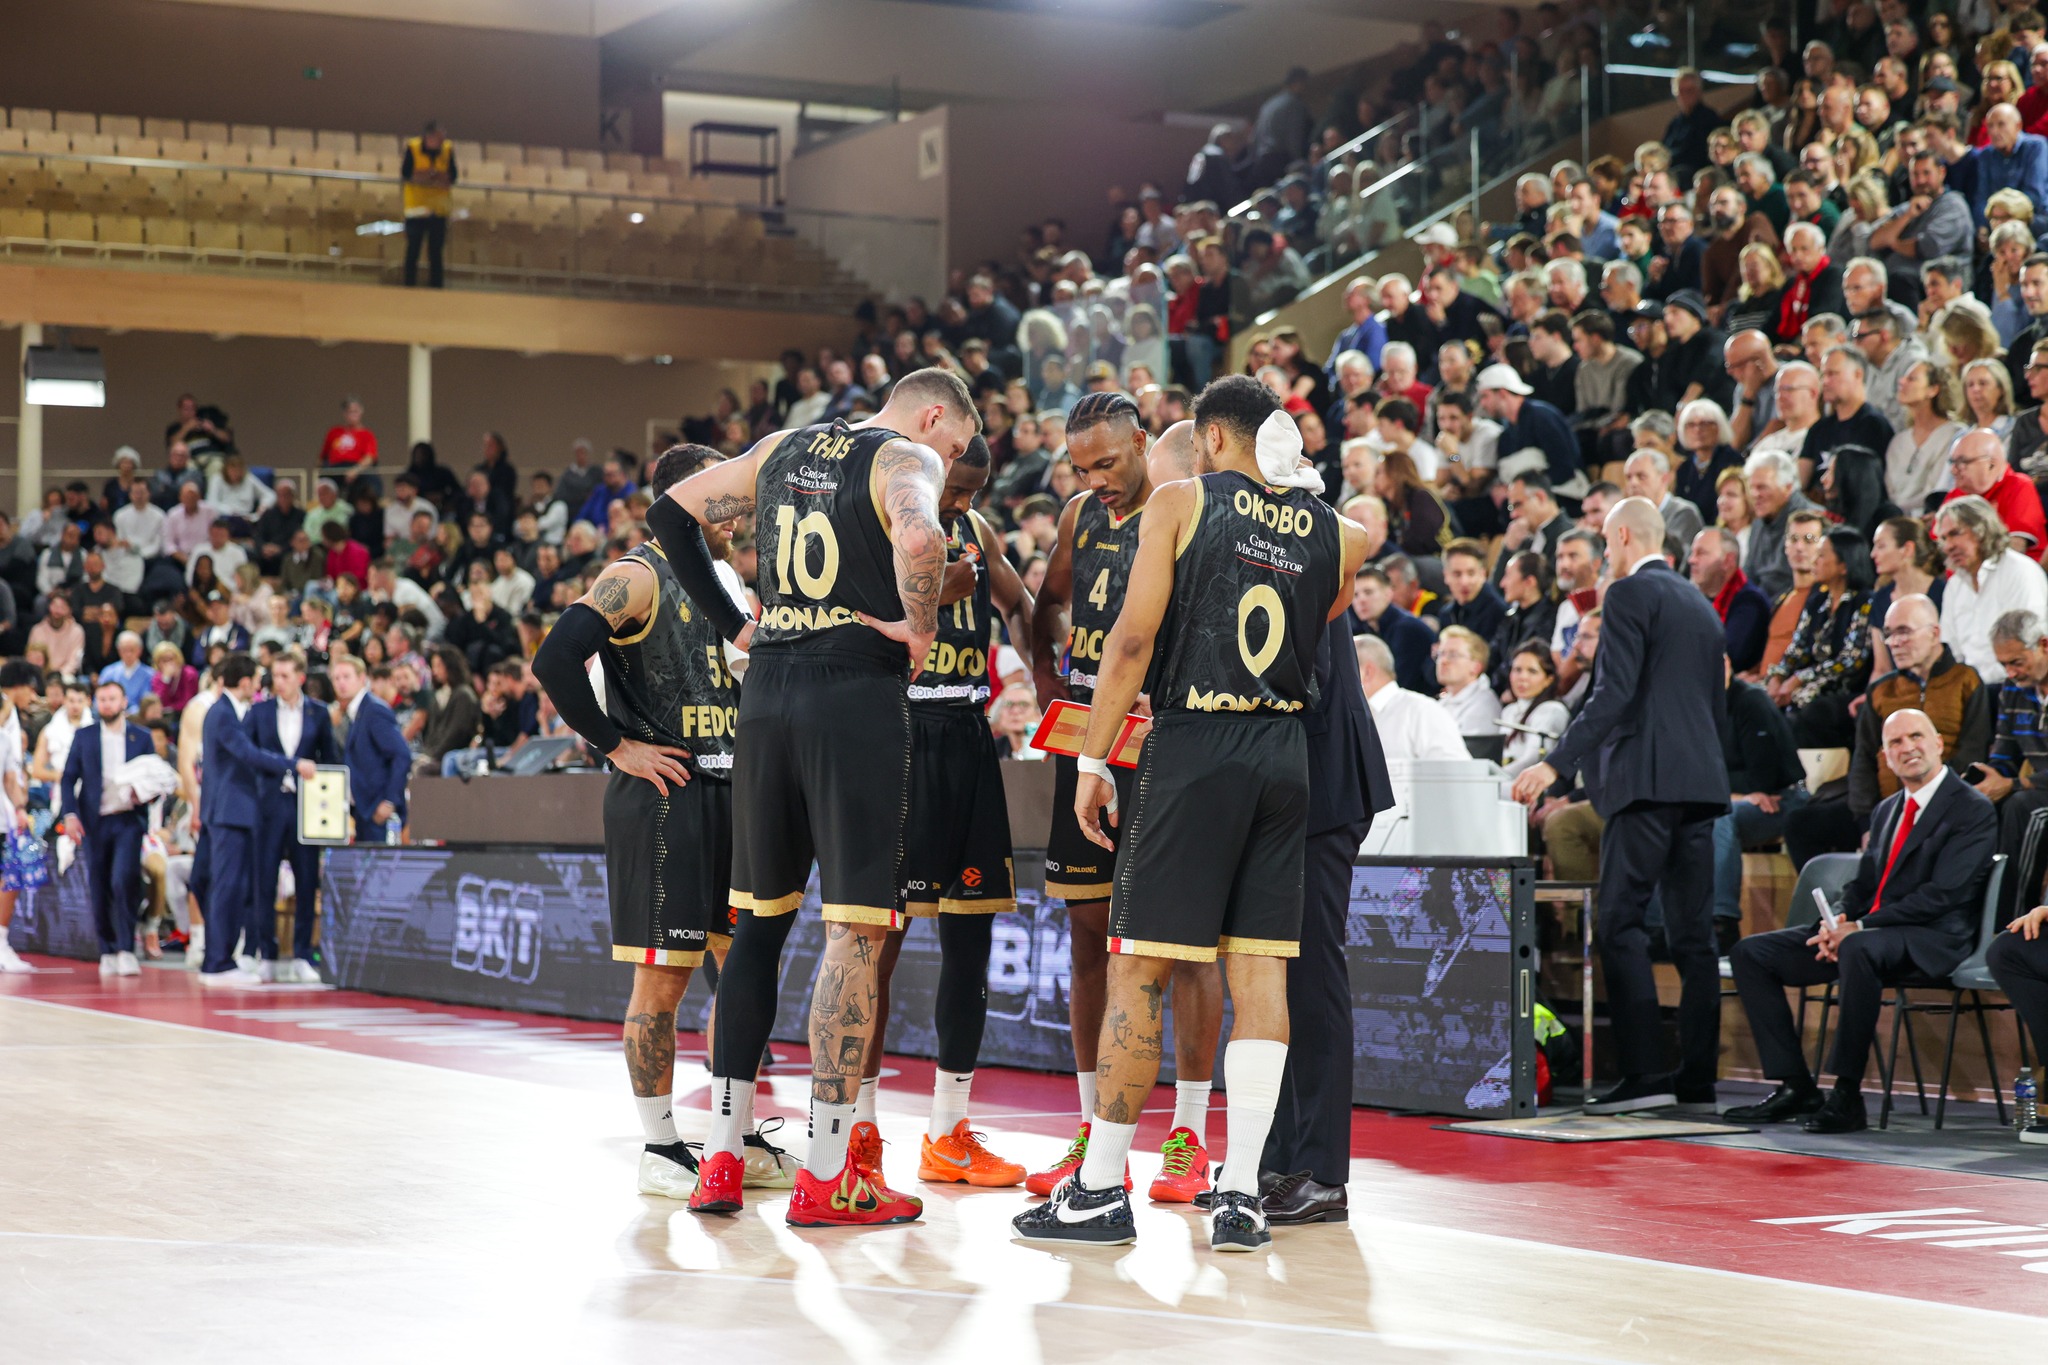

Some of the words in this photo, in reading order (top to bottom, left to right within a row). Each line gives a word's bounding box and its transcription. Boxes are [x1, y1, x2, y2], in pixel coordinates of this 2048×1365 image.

[1234, 489, 1313, 537] OKOBO
[776, 505, 839, 600] 10
[1235, 541, 1269, 561] MICHEL
[1088, 568, 1110, 611] 4
[1238, 584, 1285, 678] 0
[909, 641, 986, 677] EDCO
[682, 705, 739, 738] FEDC
[1065, 865, 1097, 874] SPALDING
[457, 893, 538, 965] BKT
